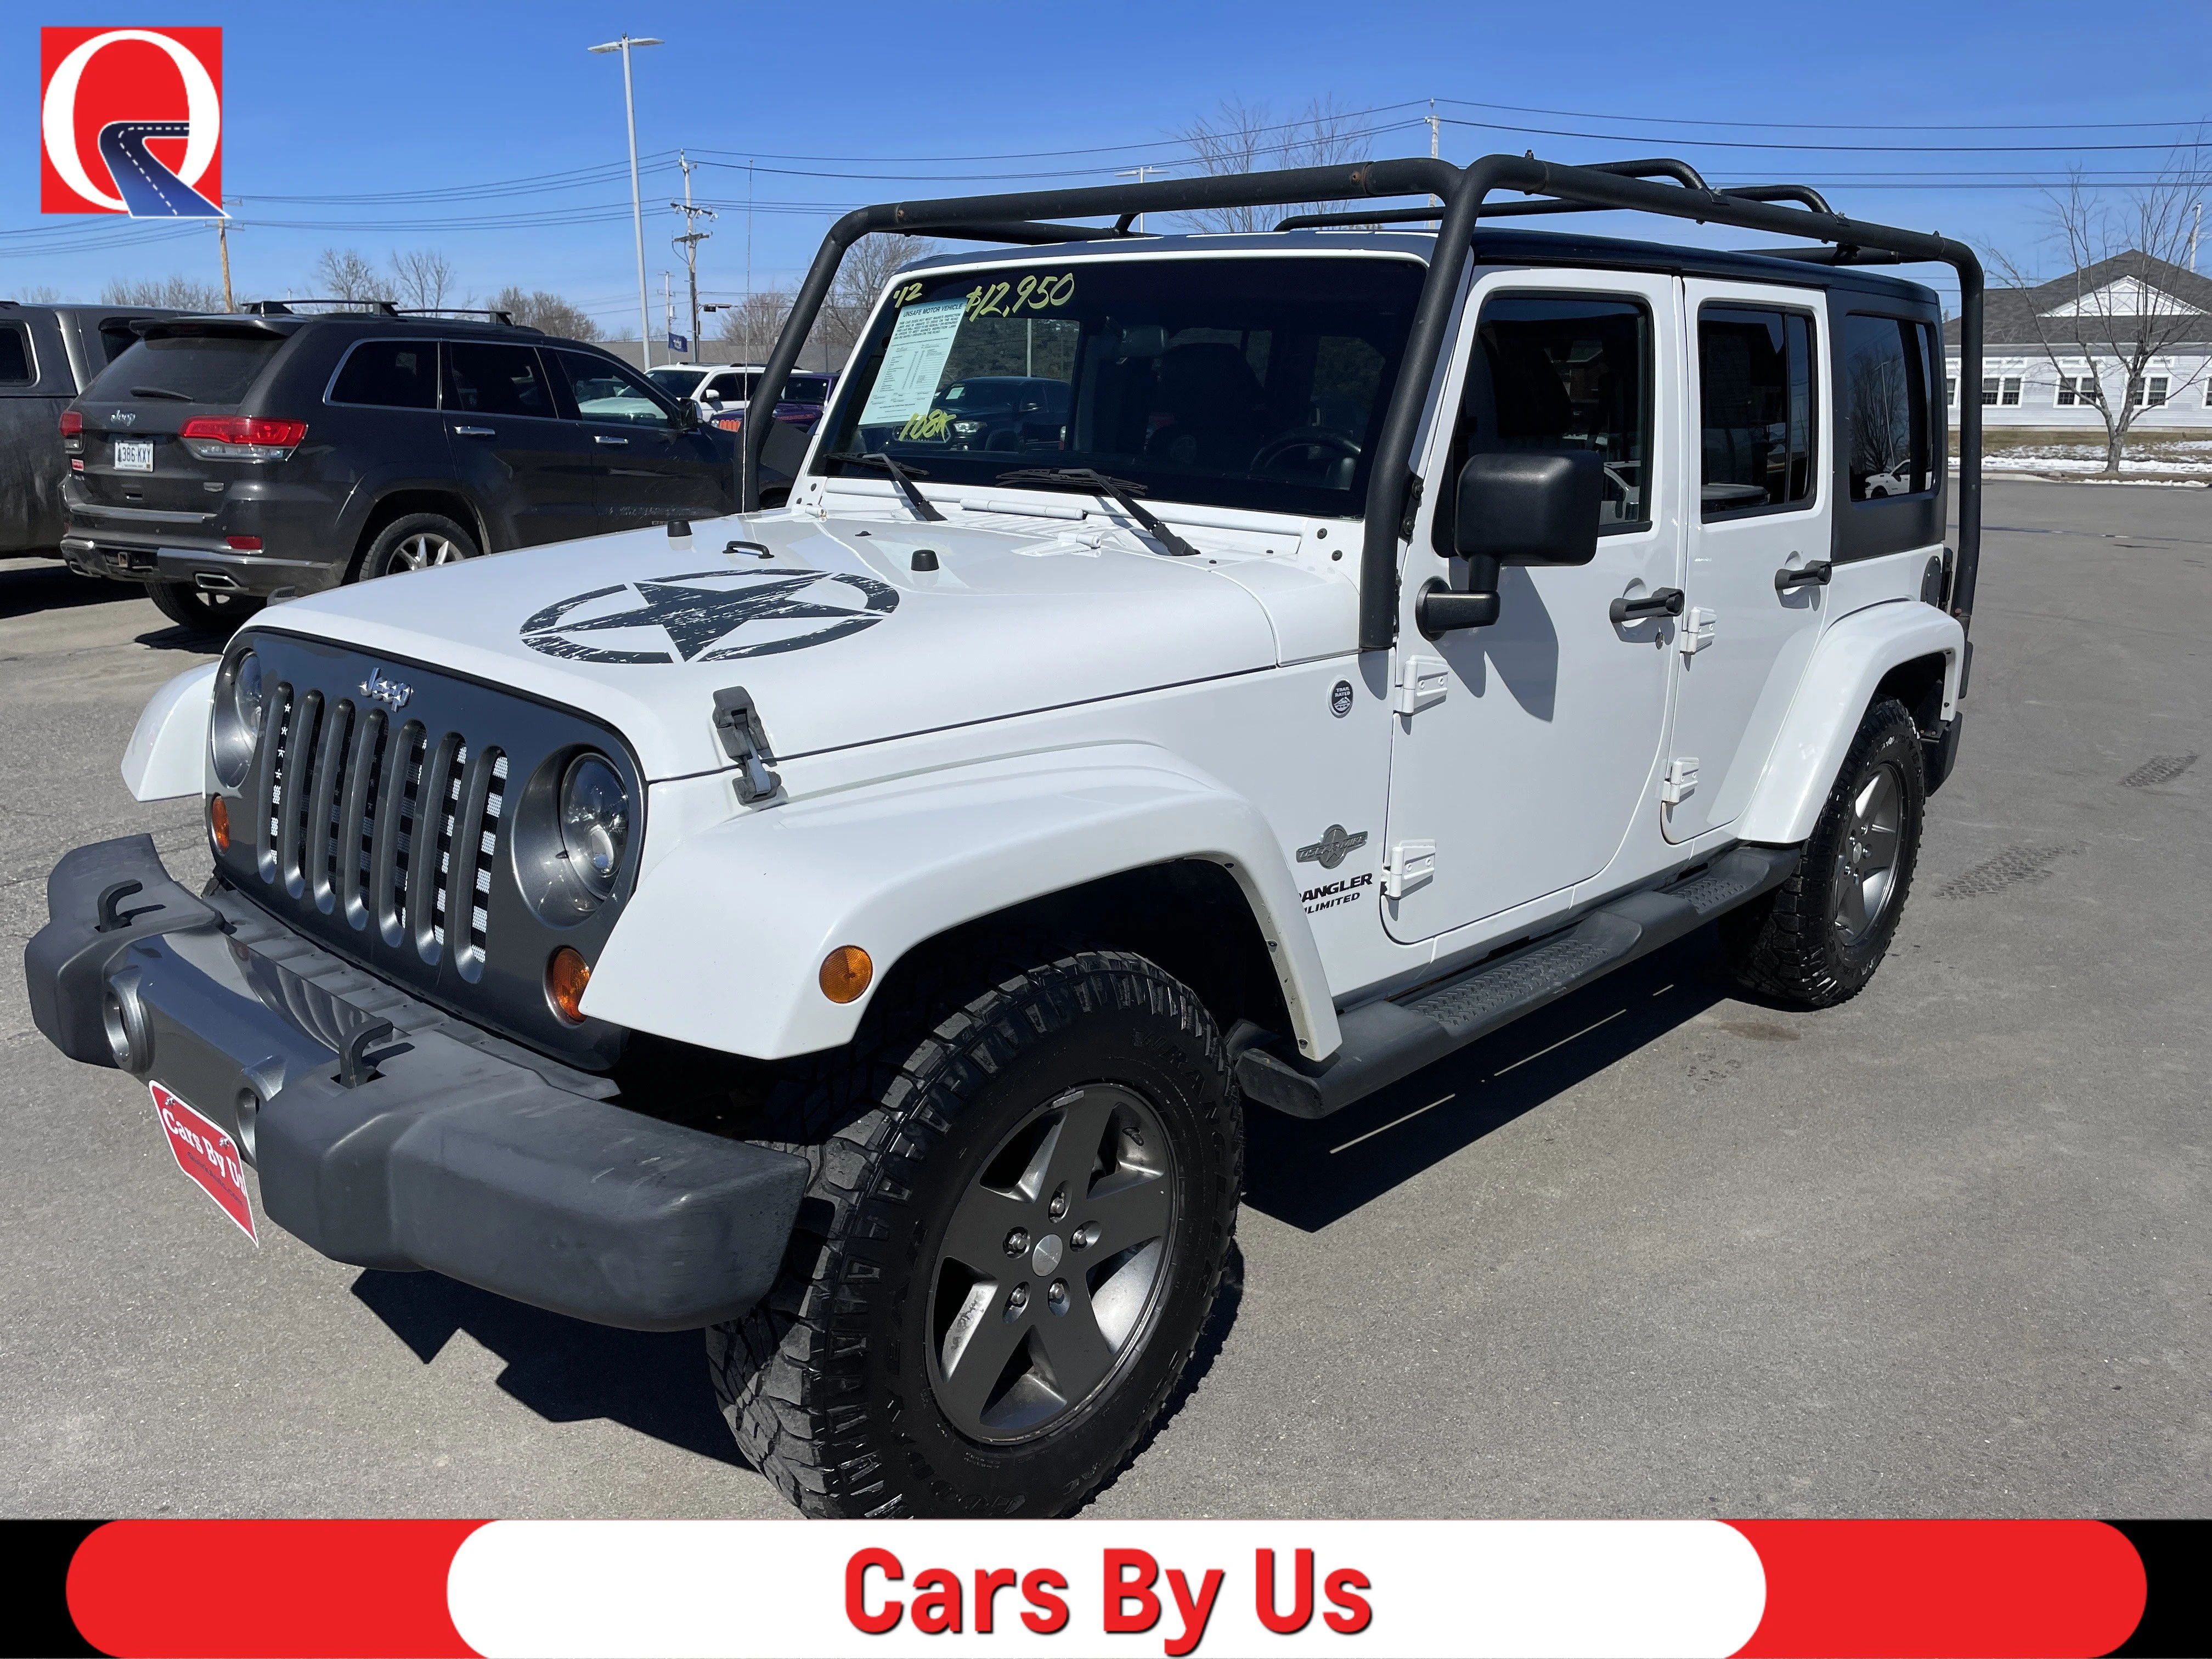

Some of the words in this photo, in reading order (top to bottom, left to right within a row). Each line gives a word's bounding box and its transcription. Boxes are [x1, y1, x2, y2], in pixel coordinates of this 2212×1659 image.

[903, 309, 922, 317] UNSAFE
[941, 303, 963, 312] VEHICLE
[965, 273, 1075, 322] $12,950
[359, 667, 413, 712] Jeep
[1300, 842, 1339, 859] OSCAR
[1340, 836, 1365, 849] MIKE
[1299, 873, 1373, 902] ANGLER
[162, 1108, 204, 1154] Cars
[201, 1136, 225, 1178] By
